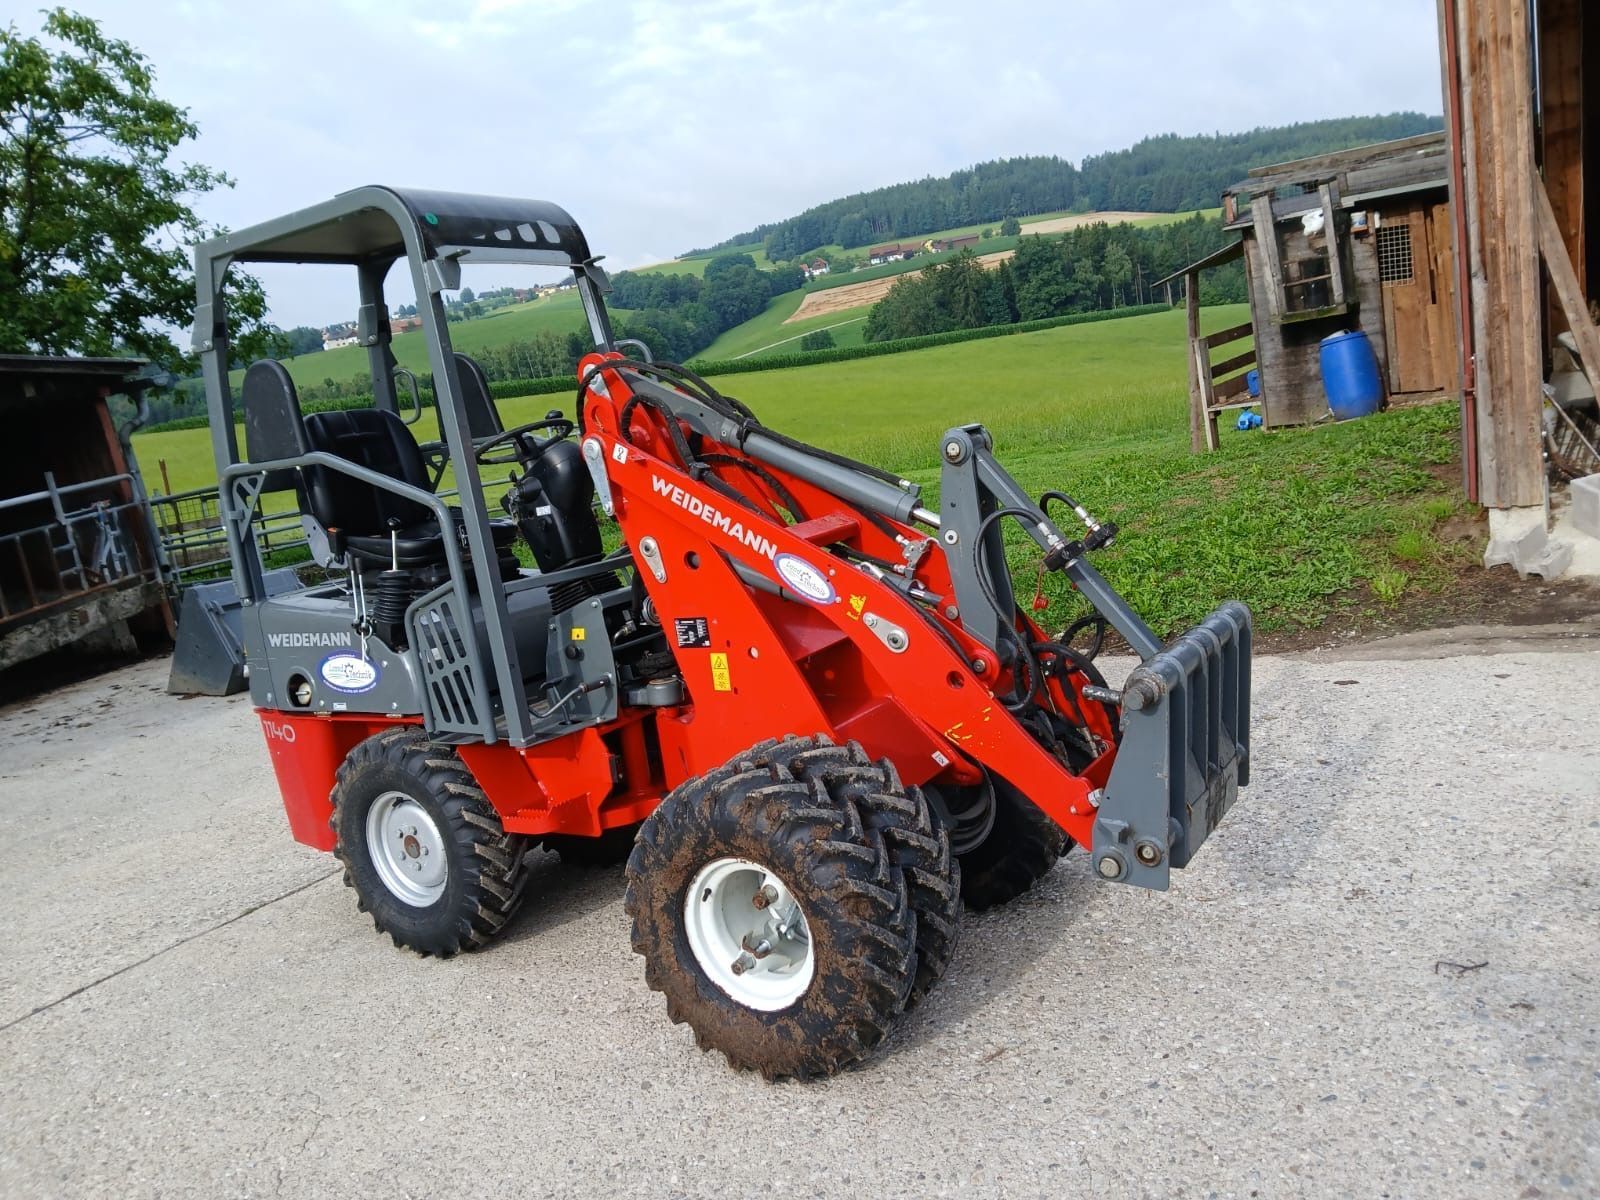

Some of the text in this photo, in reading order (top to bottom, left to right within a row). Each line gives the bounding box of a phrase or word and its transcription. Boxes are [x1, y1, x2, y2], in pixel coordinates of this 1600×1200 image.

[652, 474, 778, 561] WEIDEMANN
[268, 633, 351, 647] WEIDEMANN
[263, 719, 296, 743] 1140
